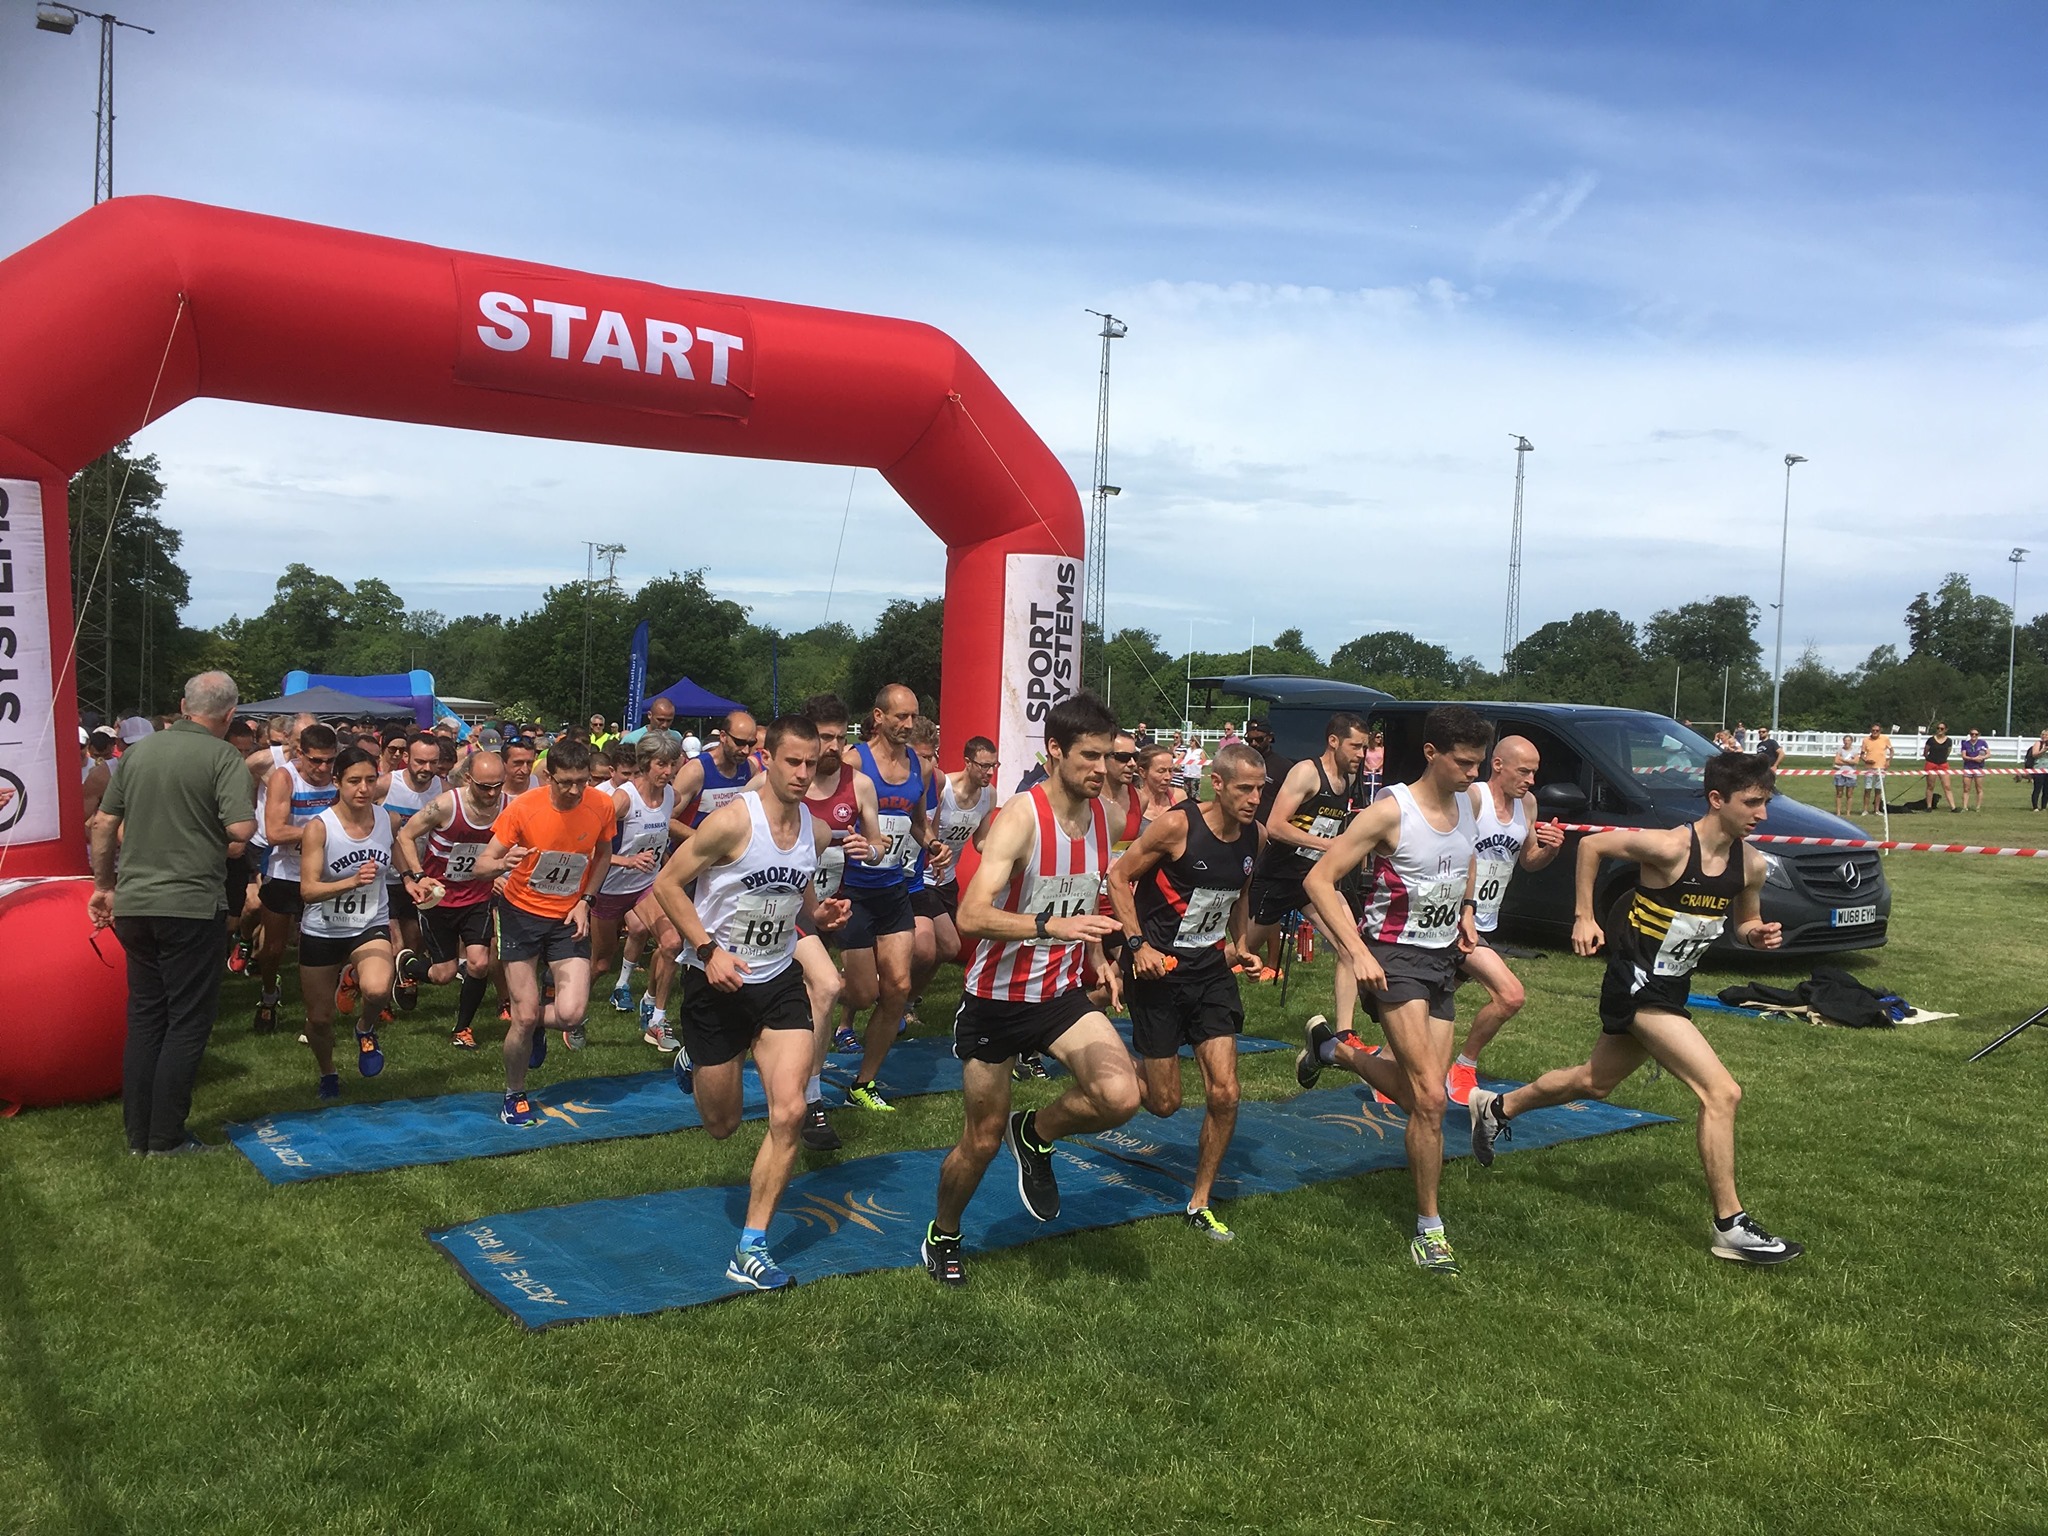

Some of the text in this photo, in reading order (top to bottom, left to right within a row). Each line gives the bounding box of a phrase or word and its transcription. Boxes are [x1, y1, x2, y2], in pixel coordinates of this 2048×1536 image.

[477, 291, 744, 386] START
[1051, 562, 1075, 712] YSTEMS
[1026, 602, 1055, 723] SPORT
[1318, 807, 1344, 818] CRAWLEY
[886, 818, 895, 830] hj
[947, 826, 973, 840] 226
[1475, 834, 1521, 856] PHOENIX
[330, 849, 390, 874] PHOENIX
[559, 853, 571, 866] hj
[1437, 855, 1452, 876] hj
[545, 867, 571, 884] 41
[1489, 863, 1499, 875] hj
[1059, 878, 1073, 895] hj
[1440, 884, 1452, 899] hj
[1478, 879, 1499, 901] 60
[334, 894, 367, 914] 161
[763, 899, 778, 917] hj
[1212, 893, 1225, 908] hj
[1680, 894, 1732, 910] CRAWLEY
[1197, 911, 1223, 934] 13
[1417, 901, 1458, 928] 306
[1838, 908, 1875, 924] WU68 EYH
[743, 920, 785, 947] 181
